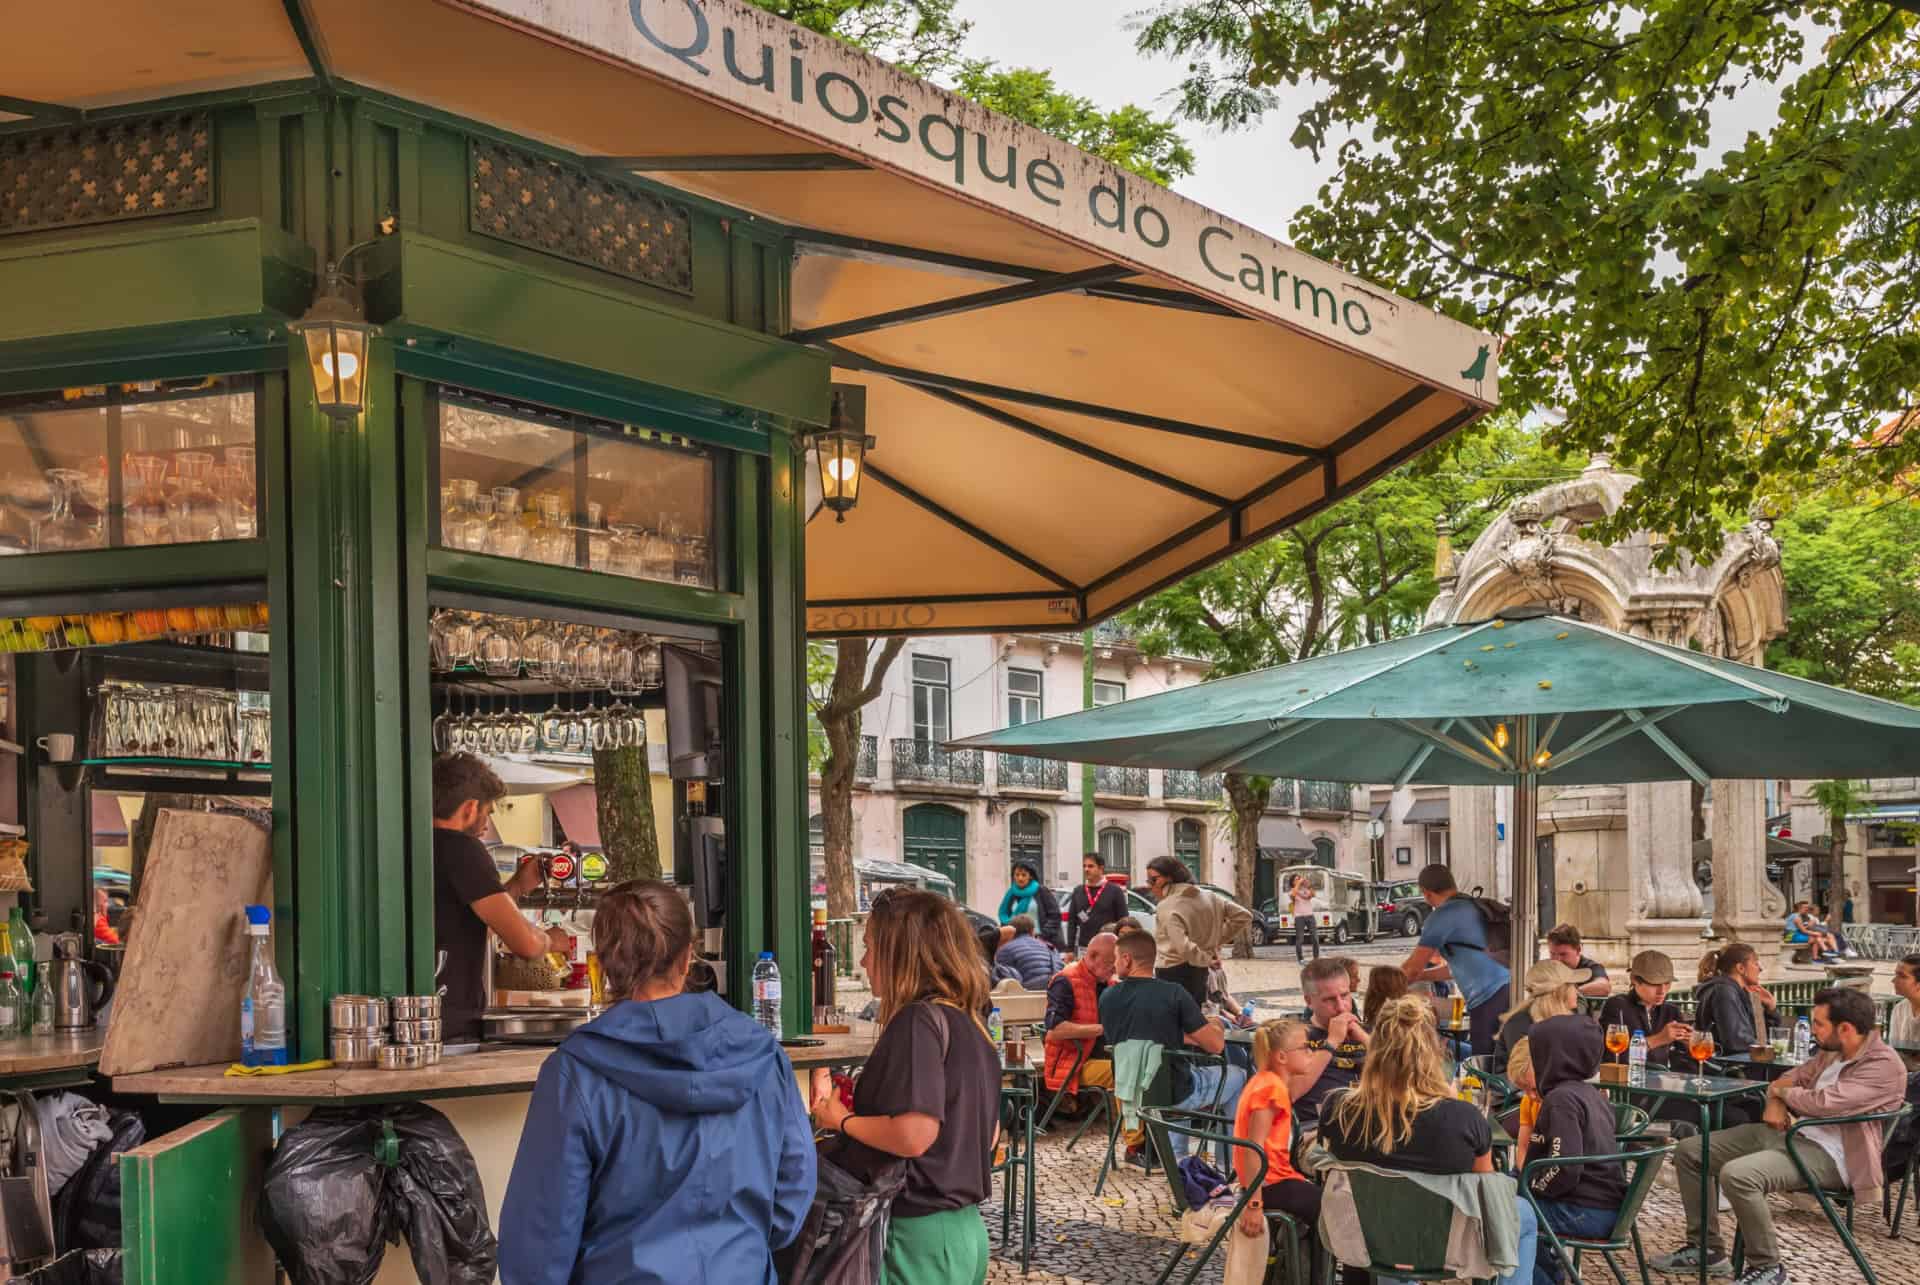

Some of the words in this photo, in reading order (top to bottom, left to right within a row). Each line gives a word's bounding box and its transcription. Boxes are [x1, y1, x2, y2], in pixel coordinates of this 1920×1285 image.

[629, 0, 1065, 206] Quiosque
[1089, 176, 1170, 248] do
[1198, 226, 1372, 335] Carmo
